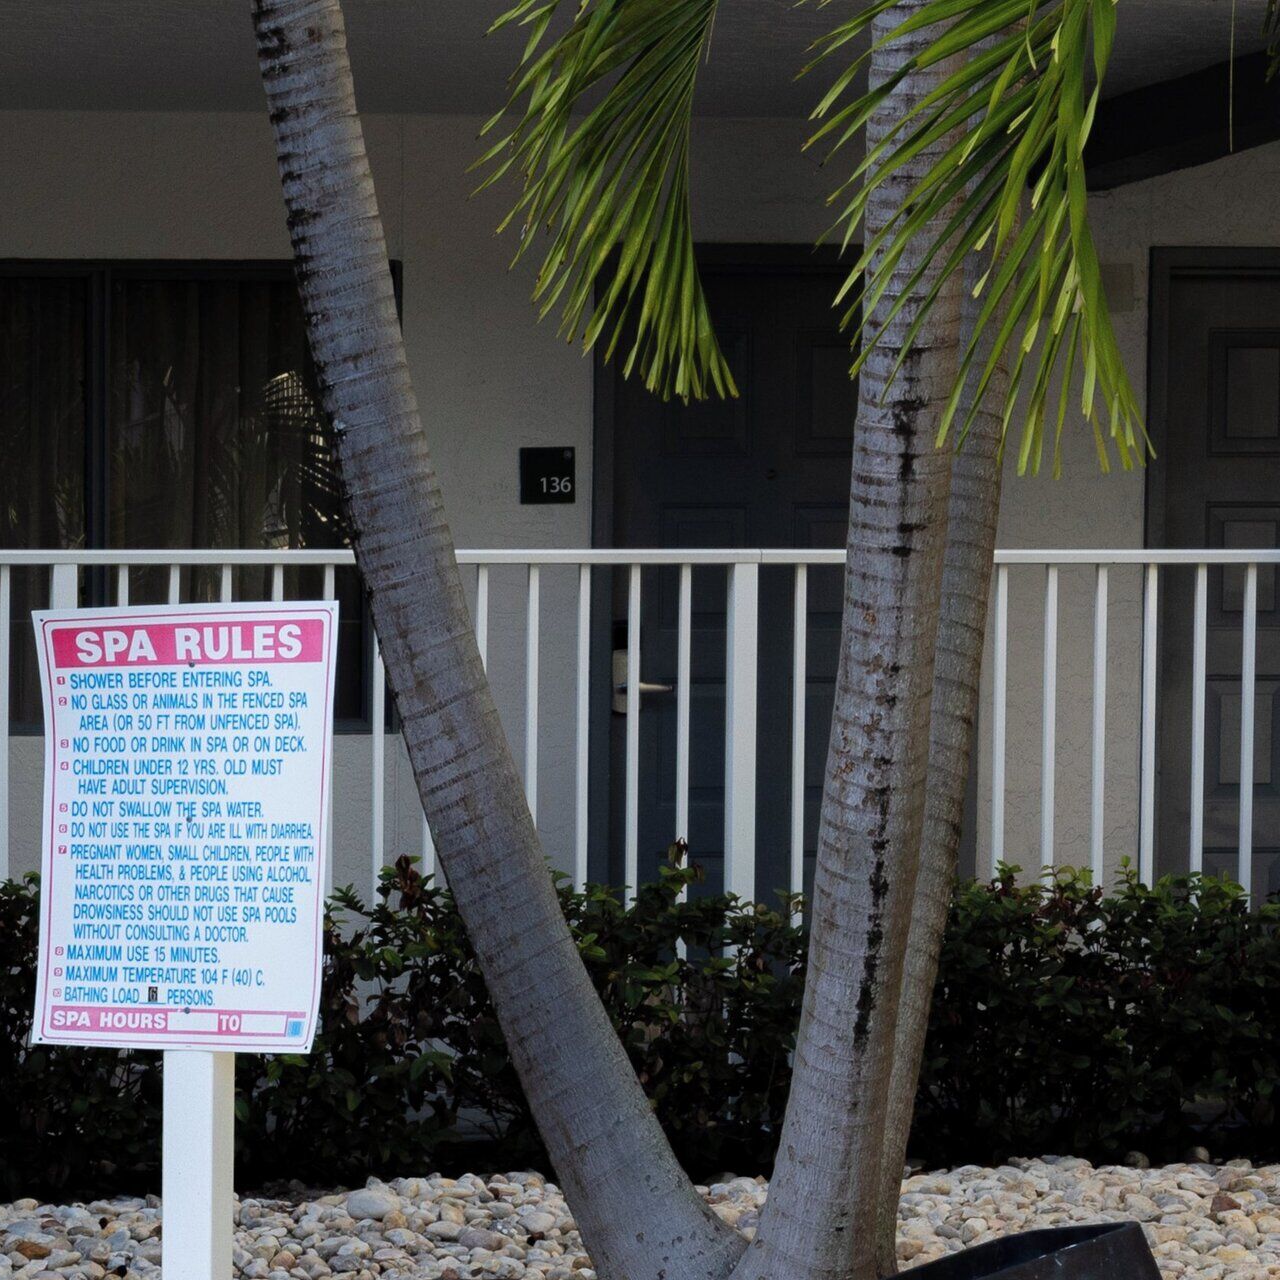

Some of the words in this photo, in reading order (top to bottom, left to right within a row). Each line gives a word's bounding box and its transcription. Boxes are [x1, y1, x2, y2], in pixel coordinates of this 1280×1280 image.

[540, 476, 572, 493] 136
[75, 629, 157, 663] SPA
[175, 625, 303, 660] RULES
[57, 676, 65, 685] 1
[70, 673, 123, 689] SHOWER
[129, 672, 177, 688] BEFORE
[183, 672, 242, 687] ENTERING
[248, 671, 272, 686] SPA.
[59, 697, 67, 706] 2
[72, 695, 87, 710] NO
[92, 694, 127, 710] GLASS
[134, 694, 147, 709] OR
[153, 694, 198, 709] ANIMALS
[203, 694, 213, 708] IN
[218, 693, 237, 708] THE
[243, 693, 283, 708] FENCED
[289, 692, 307, 707] SPA
[80, 716, 108, 731] AREA
[113, 715, 133, 732] (OR
[138, 715, 152, 730] 50
[157, 715, 169, 729] FT
[175, 715, 205, 729] FROM
[211, 715, 269, 729] UNFENCED
[274, 714, 300, 731] SPA).
[73, 737, 89, 752] NO
[95, 737, 125, 752] FOOD
[131, 737, 146, 752] OR
[153, 737, 185, 752] DRINK
[191, 737, 201, 752] IN
[207, 737, 227, 752] SPA
[233, 737, 249, 752] OR
[254, 737, 270, 752] ON
[275, 737, 307, 752] DECK.
[73, 760, 128, 775] CHILDREN
[134, 760, 172, 775] UNDER
[178, 760, 189, 774] 12
[194, 760, 219, 775] YRS.
[224, 760, 246, 774] OLD
[252, 759, 282, 774] MUST
[79, 780, 106, 794] HAVE
[112, 780, 146, 794] ADULT
[152, 780, 228, 794] SUPERVISION.
[72, 802, 87, 816] DO
[93, 802, 114, 816] NOT
[119, 802, 171, 817] SWALLOW
[178, 802, 196, 817] THE
[202, 802, 221, 817] SPA
[227, 802, 263, 817] WATER.
[72, 823, 84, 837] DO
[89, 823, 107, 838] NOT
[112, 823, 129, 838] USE
[133, 823, 149, 838] THE
[154, 823, 170, 838] SPA
[175, 823, 182, 838] IF
[187, 823, 204, 838] YOU
[208, 823, 224, 838] ARE
[230, 824, 241, 838] ILL
[246, 824, 267, 839] WITH
[58, 845, 67, 854] 7
[71, 845, 121, 859] PREGNANT
[126, 845, 163, 862] WOMEN,
[168, 845, 198, 860] SMALL
[203, 846, 251, 863] CHILDREN,
[256, 846, 289, 861] PEOPLE
[294, 846, 314, 861] WITH
[76, 865, 113, 879] HEALTH
[118, 865, 174, 881] PROBLEMS,
[179, 866, 185, 880] &
[191, 866, 227, 880] PEOPLE
[232, 866, 262, 881] USING
[267, 866, 312, 884] ALCOHOL,
[75, 885, 133, 900] NARCOTICS
[139, 886, 153, 900] OR
[158, 886, 190, 901] OTHER
[196, 886, 229, 902] DRUGS
[234, 887, 258, 902] THAT
[263, 887, 293, 902] CAUSE
[74, 904, 143, 920] DROWSINESS
[148, 905, 188, 921] SHOULD
[194, 906, 213, 921] NOT
[218, 906, 237, 922] USE
[243, 907, 261, 922] SPA
[265, 907, 296, 923] POOLS
[74, 924, 121, 940] WITHOUT
[126, 925, 189, 941] CONSULTING
[195, 927, 200, 941] A
[205, 927, 248, 942] DOCTOR.
[67, 946, 121, 961] MAXIMUM
[127, 946, 148, 962] USE
[154, 947, 165, 962] 15
[171, 947, 220, 963] MINUTES.
[66, 967, 118, 982] MAXIMUM
[123, 968, 196, 983] TEMPERATURE
[201, 969, 217, 983] 104
[222, 969, 228, 983] F
[232, 969, 252, 985] (40)
[256, 970, 264, 985] C.
[65, 987, 108, 1003] BATHING
[113, 988, 139, 1003] LOAD
[149, 987, 157, 1001] 6
[168, 990, 215, 1005] PERSONS.
[53, 1011, 91, 1027] SPA
[100, 1013, 166, 1029] HOURS
[221, 1015, 240, 1031] TO
